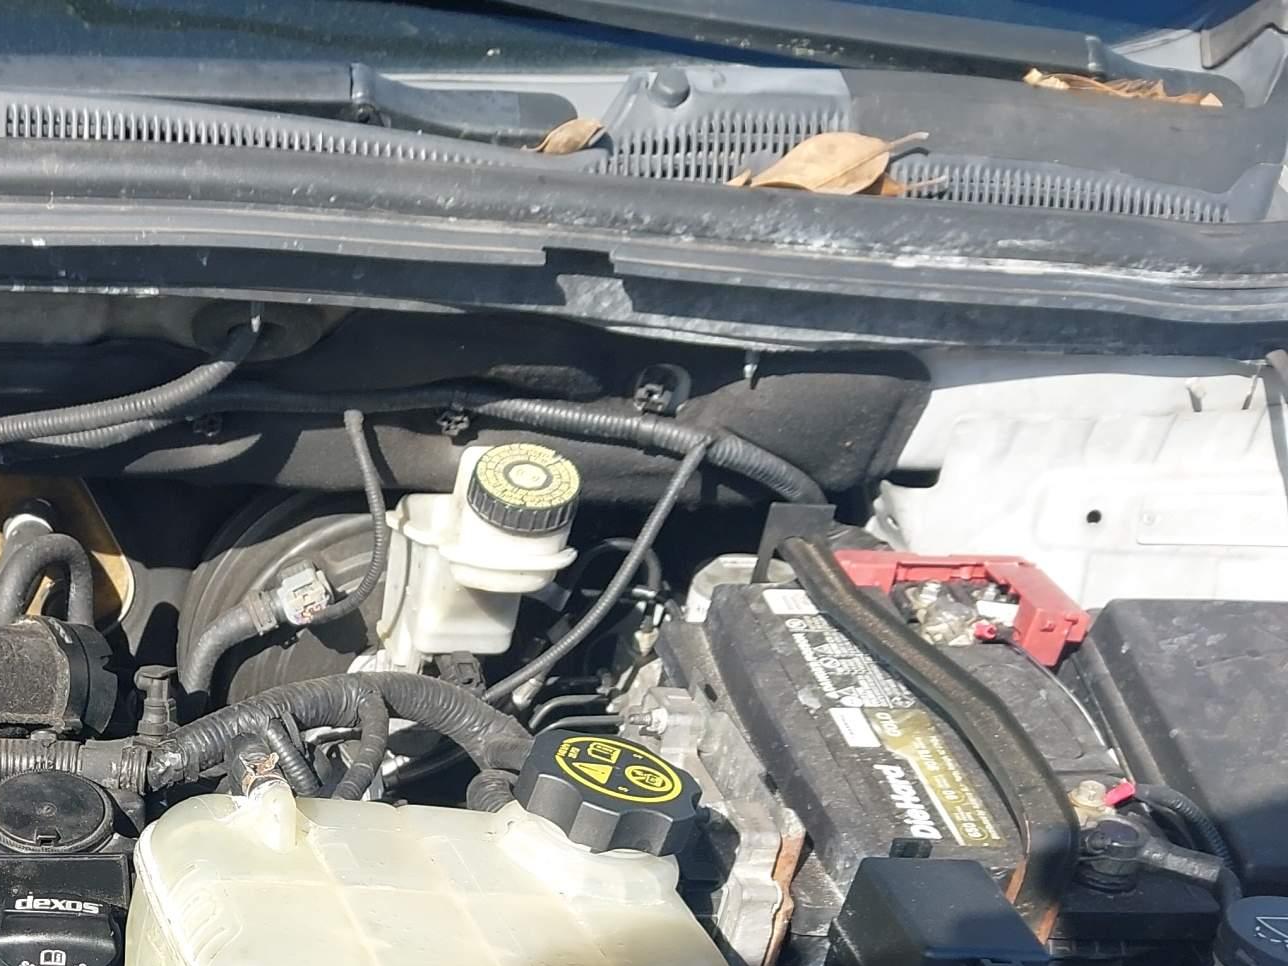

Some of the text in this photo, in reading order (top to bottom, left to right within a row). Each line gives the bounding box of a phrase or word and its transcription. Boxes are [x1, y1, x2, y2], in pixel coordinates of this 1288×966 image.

[875, 712, 902, 737] GOLD
[873, 764, 943, 839] DieHard
[14, 892, 100, 914] dexos
